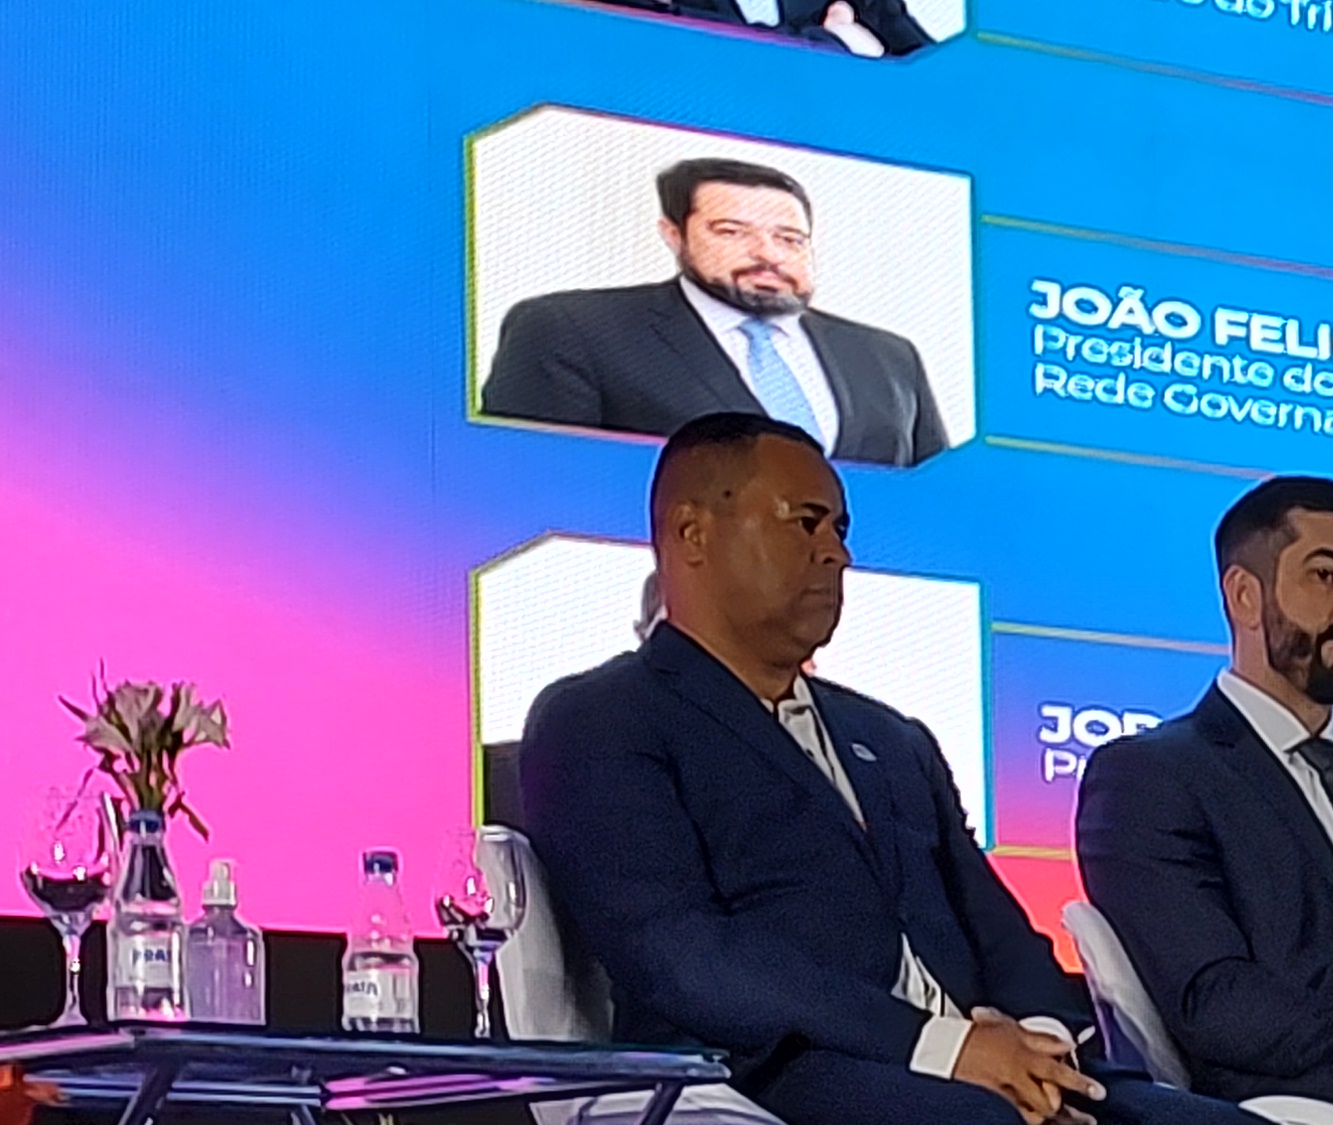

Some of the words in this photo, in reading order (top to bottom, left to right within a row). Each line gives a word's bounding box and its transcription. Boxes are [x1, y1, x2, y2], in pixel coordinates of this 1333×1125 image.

[1028, 278, 1201, 338] JOÃO
[1033, 323, 1276, 386] Presidente
[1033, 362, 1156, 410] Rede
